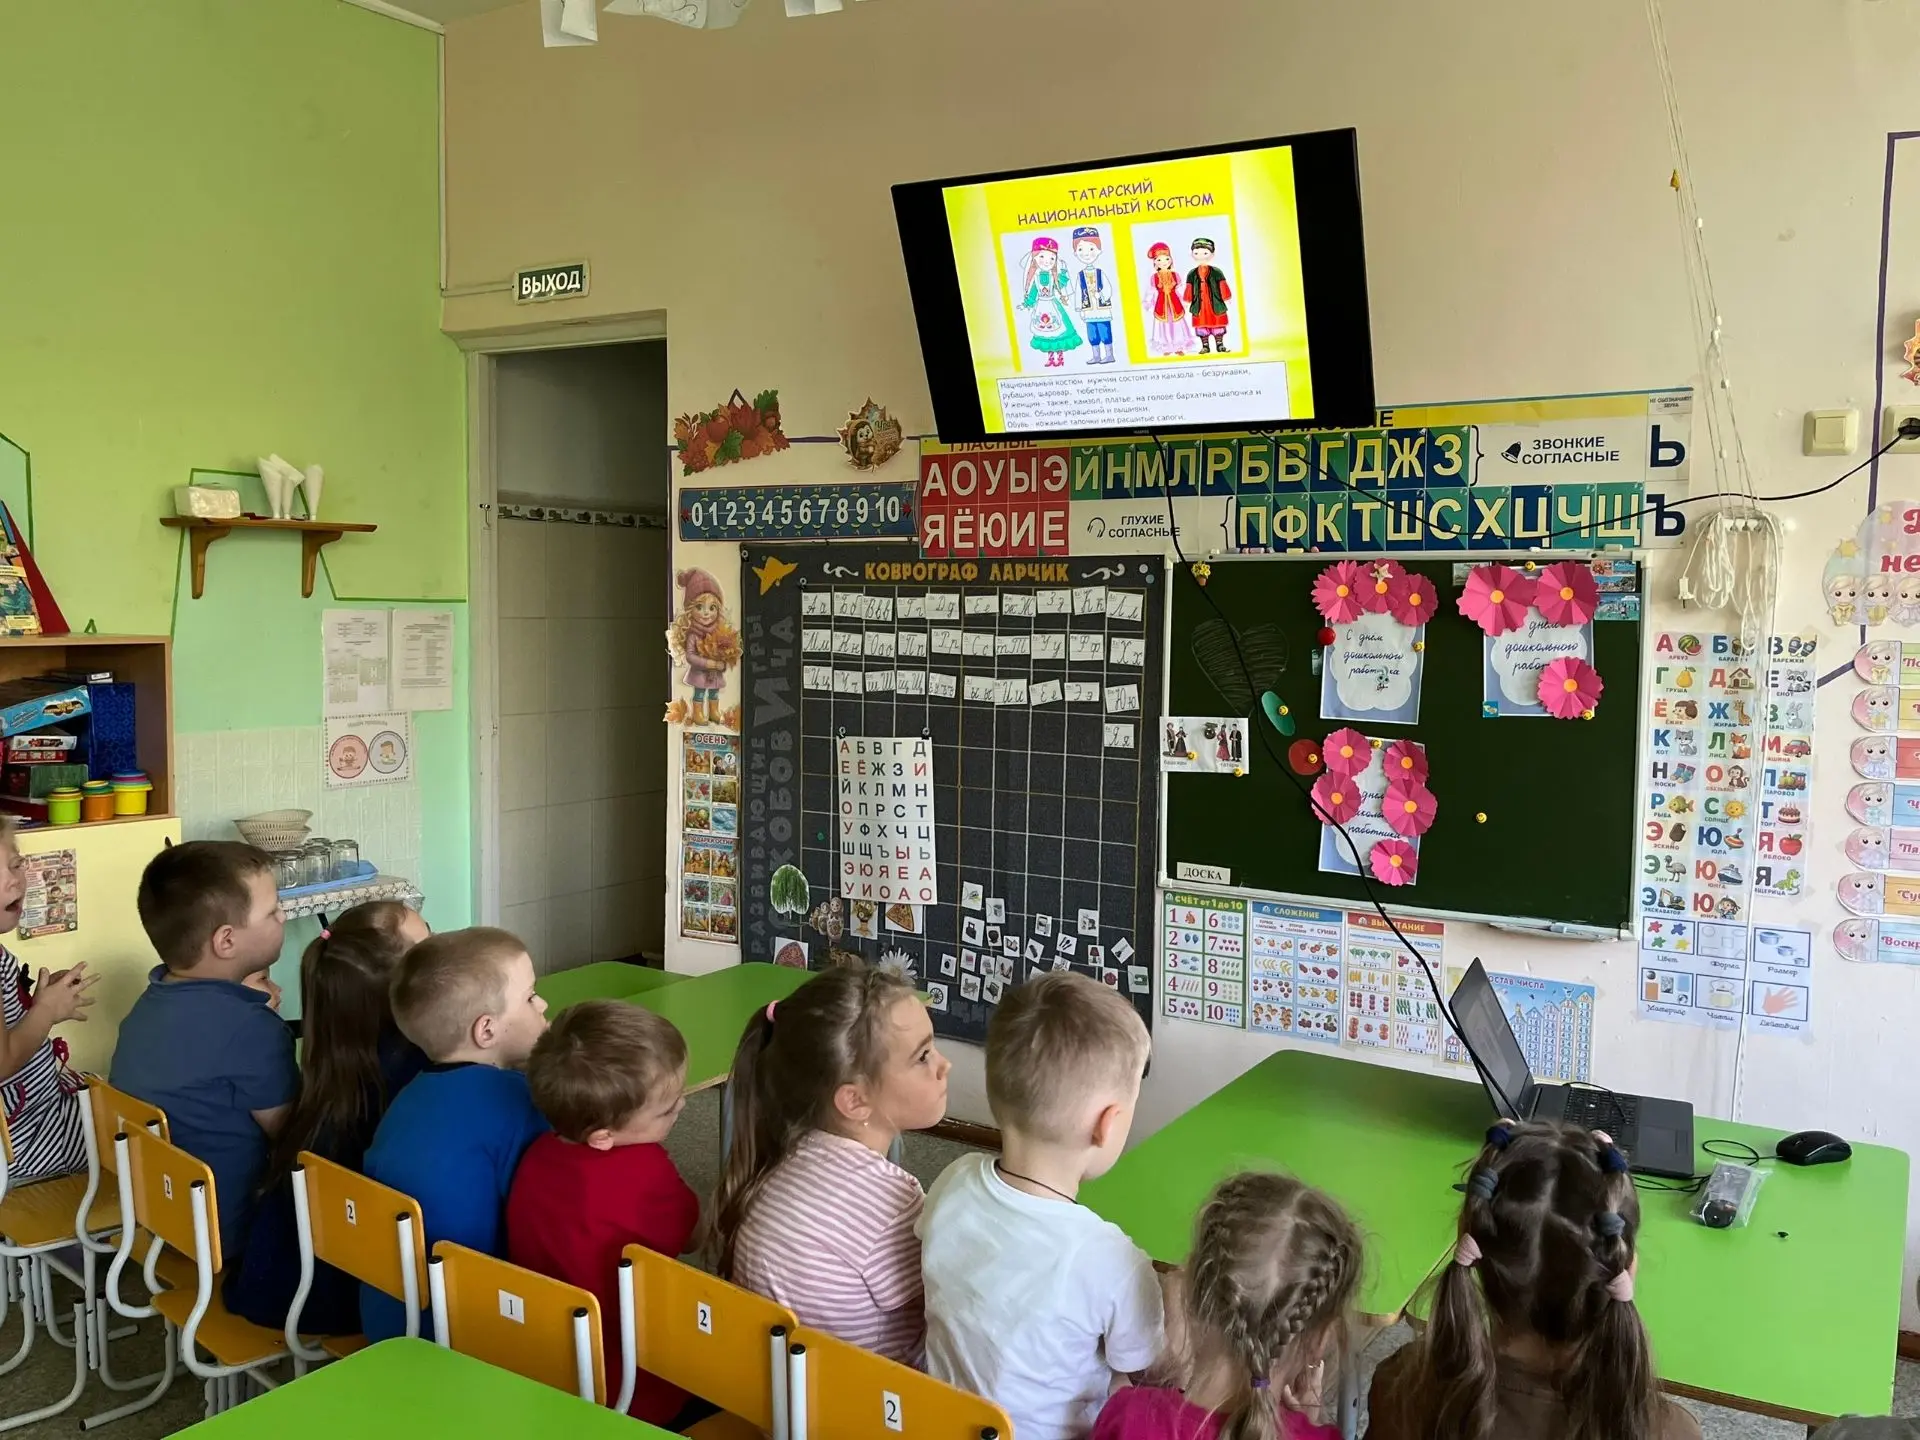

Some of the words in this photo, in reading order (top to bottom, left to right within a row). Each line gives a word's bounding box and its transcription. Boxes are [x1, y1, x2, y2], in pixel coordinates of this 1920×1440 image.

[1069, 178, 1153, 201] ТАТАРСКИЙ
[1018, 197, 1141, 225] НАЦИОНАЛЬНЫЙ
[1147, 193, 1214, 211] КОСТЮМ
[521, 270, 581, 295] ВЫХОД
[1162, 372, 1194, 380] камзола
[1532, 436, 1606, 451] ЗВОНКИЕ
[1649, 424, 1686, 469] Ь
[1522, 449, 1620, 465] СОГЛАСНЫЕ
[692, 502, 703, 527] 0
[708, 502, 718, 526] 1
[726, 501, 738, 526] 2
[744, 500, 756, 526] 3
[761, 500, 774, 525] 4
[780, 500, 792, 525] 5
[800, 499, 812, 524] 6
[818, 499, 830, 523] 7
[836, 498, 849, 523] 8
[855, 497, 869, 523] 9
[875, 496, 900, 523] 10
[1646, 493, 1686, 537] Ъ
[1121, 515, 1165, 528] ГЛУХИЕ
[1108, 525, 1181, 539] СОГЛАСНЫЕ
[864, 562, 979, 582] КОВРОГРАФ
[990, 562, 1069, 582] ЛАРЧИК
[1346, 629, 1353, 640] С
[1359, 633, 1383, 647] днем
[1656, 634, 1673, 652] А
[1713, 636, 1728, 653] Б
[1343, 651, 1404, 664] дошкольного
[1505, 642, 1579, 659] дошкольного
[1348, 664, 1400, 679] работка
[1656, 667, 1669, 684] Г
[1709, 669, 1726, 688] Д
[1655, 698, 1668, 717] Ё
[1708, 702, 1729, 719] Ж
[695, 734, 727, 745] ОСЕНЬ
[1654, 729, 1670, 747] К
[1708, 732, 1725, 750] Л
[1653, 762, 1668, 779] Н
[1706, 765, 1723, 783] О
[1651, 793, 1665, 809] Р
[1705, 797, 1719, 814] С
[1762, 802, 1774, 818] Т
[1646, 822, 1663, 841] Э
[1698, 826, 1722, 847] Ю
[1759, 832, 1773, 852] Я
[1183, 867, 1222, 881] ДОСКА
[1175, 894, 1198, 906] СЧЁТ
[1218, 901, 1229, 909] до
[1231, 900, 1243, 910] 10
[1170, 908, 1178, 923] 1
[1208, 913, 1218, 928] 6
[1274, 907, 1320, 919] СЛОЖЕНИЕ
[1169, 931, 1178, 945] 2
[1208, 936, 1218, 950] 7
[1169, 953, 1178, 968] 3
[1208, 958, 1218, 974] 8
[1168, 976, 1178, 991] 4
[1208, 982, 1218, 996] 9
[1517, 980, 1545, 989] ЧИСЛА
[1168, 998, 1178, 1013] 5
[1206, 1004, 1224, 1020] 10
[346, 1204, 355, 1222] 2
[508, 1299, 516, 1315] 1
[700, 1309, 708, 1327] 2
[886, 1400, 898, 1423] 2
